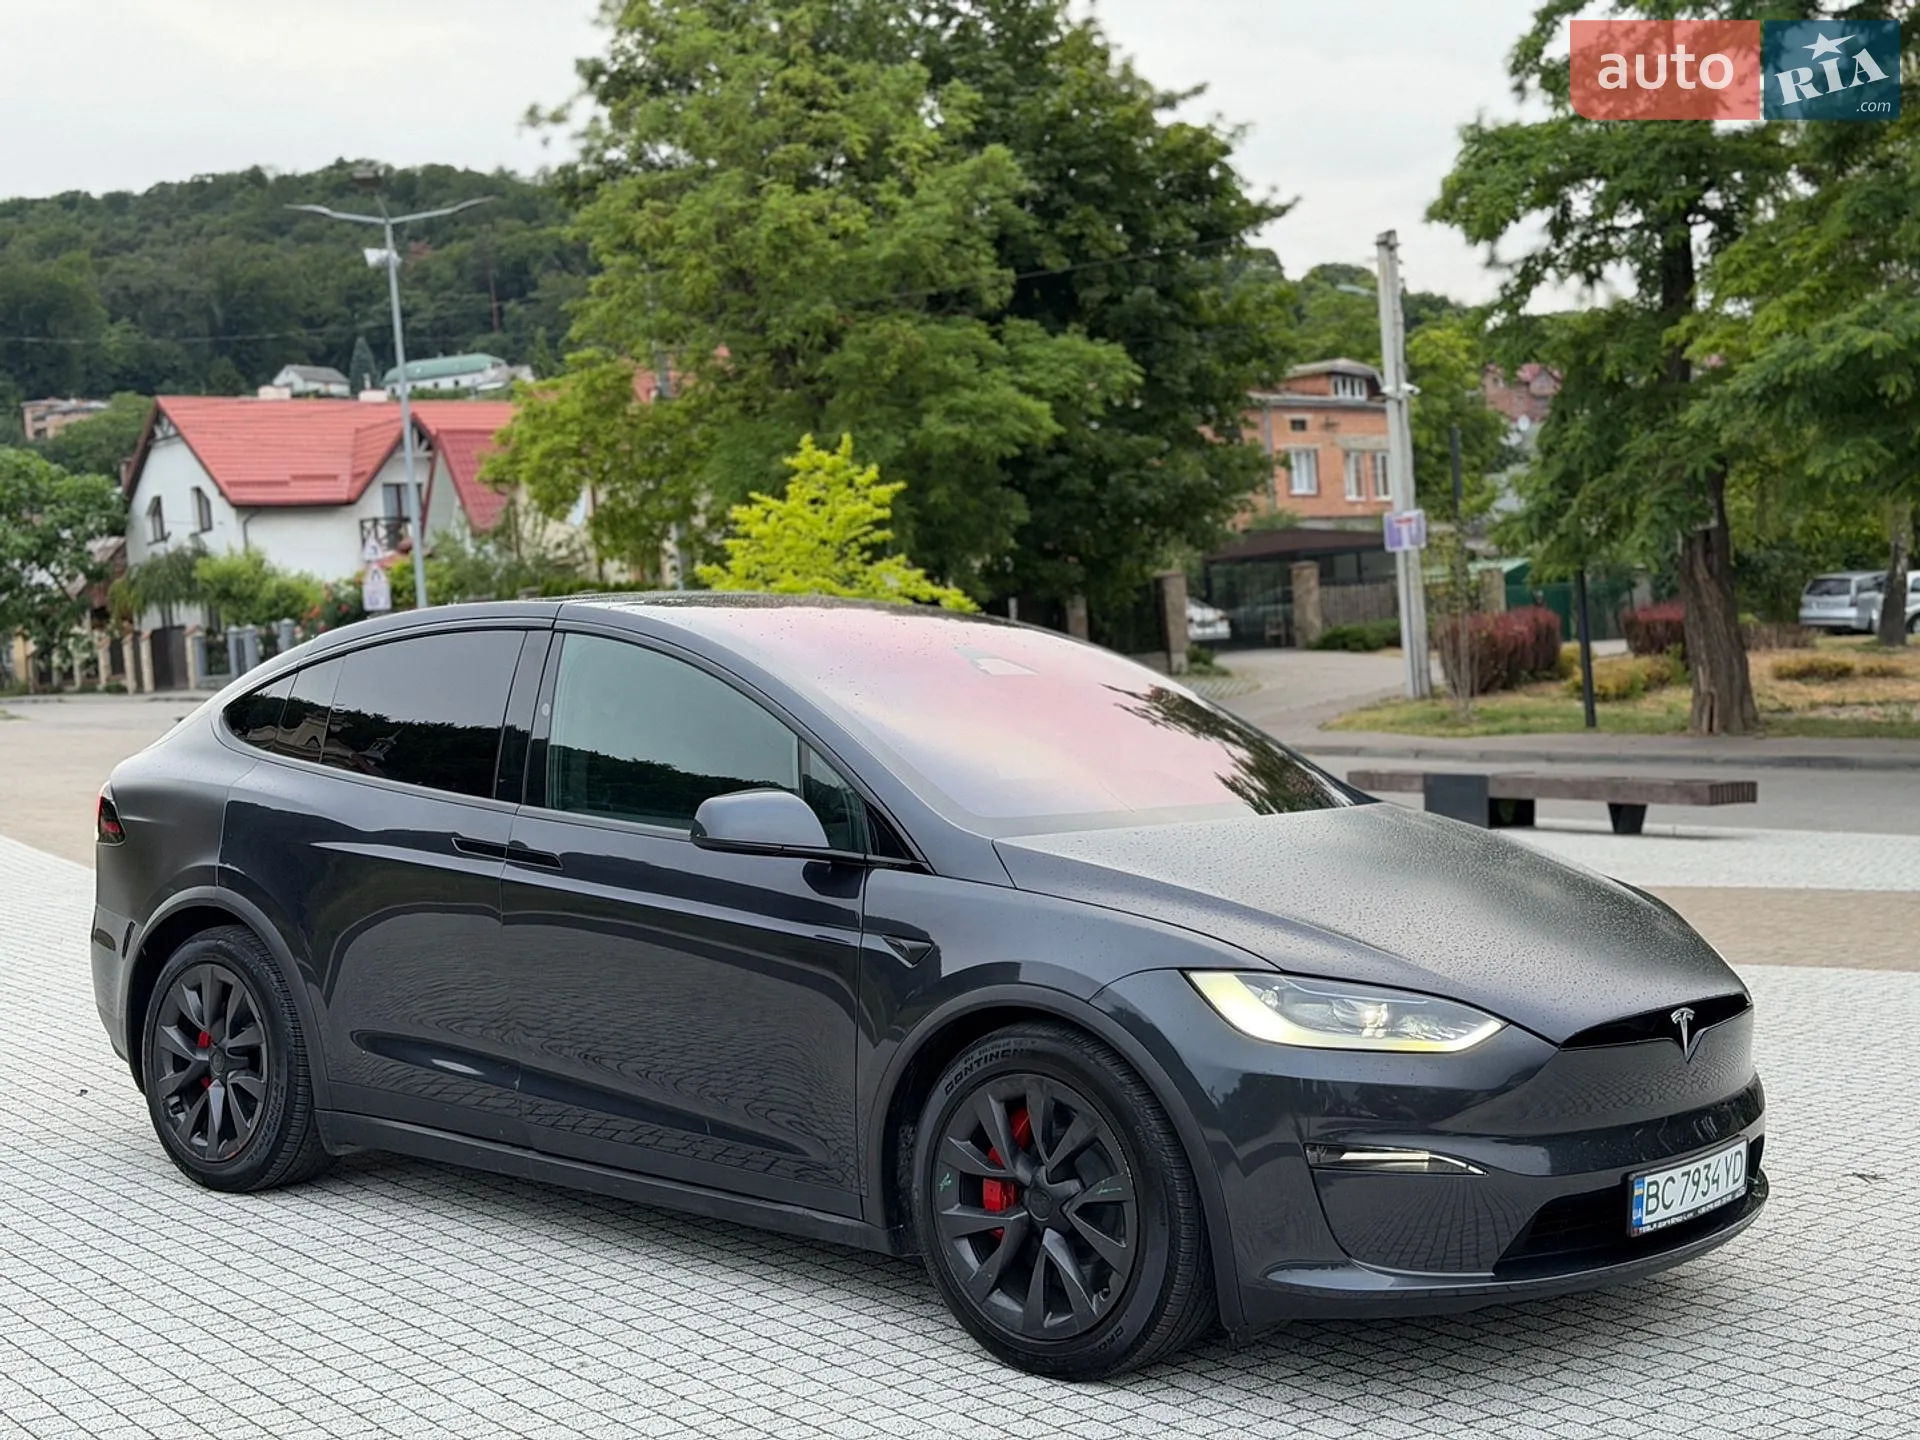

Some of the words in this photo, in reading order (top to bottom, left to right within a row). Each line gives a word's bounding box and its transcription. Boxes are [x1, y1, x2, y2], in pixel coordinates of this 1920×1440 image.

[1645, 1176, 1676, 1217] BC
[1679, 1162, 1721, 1207] 7934
[1725, 1150, 1744, 1188] YD
